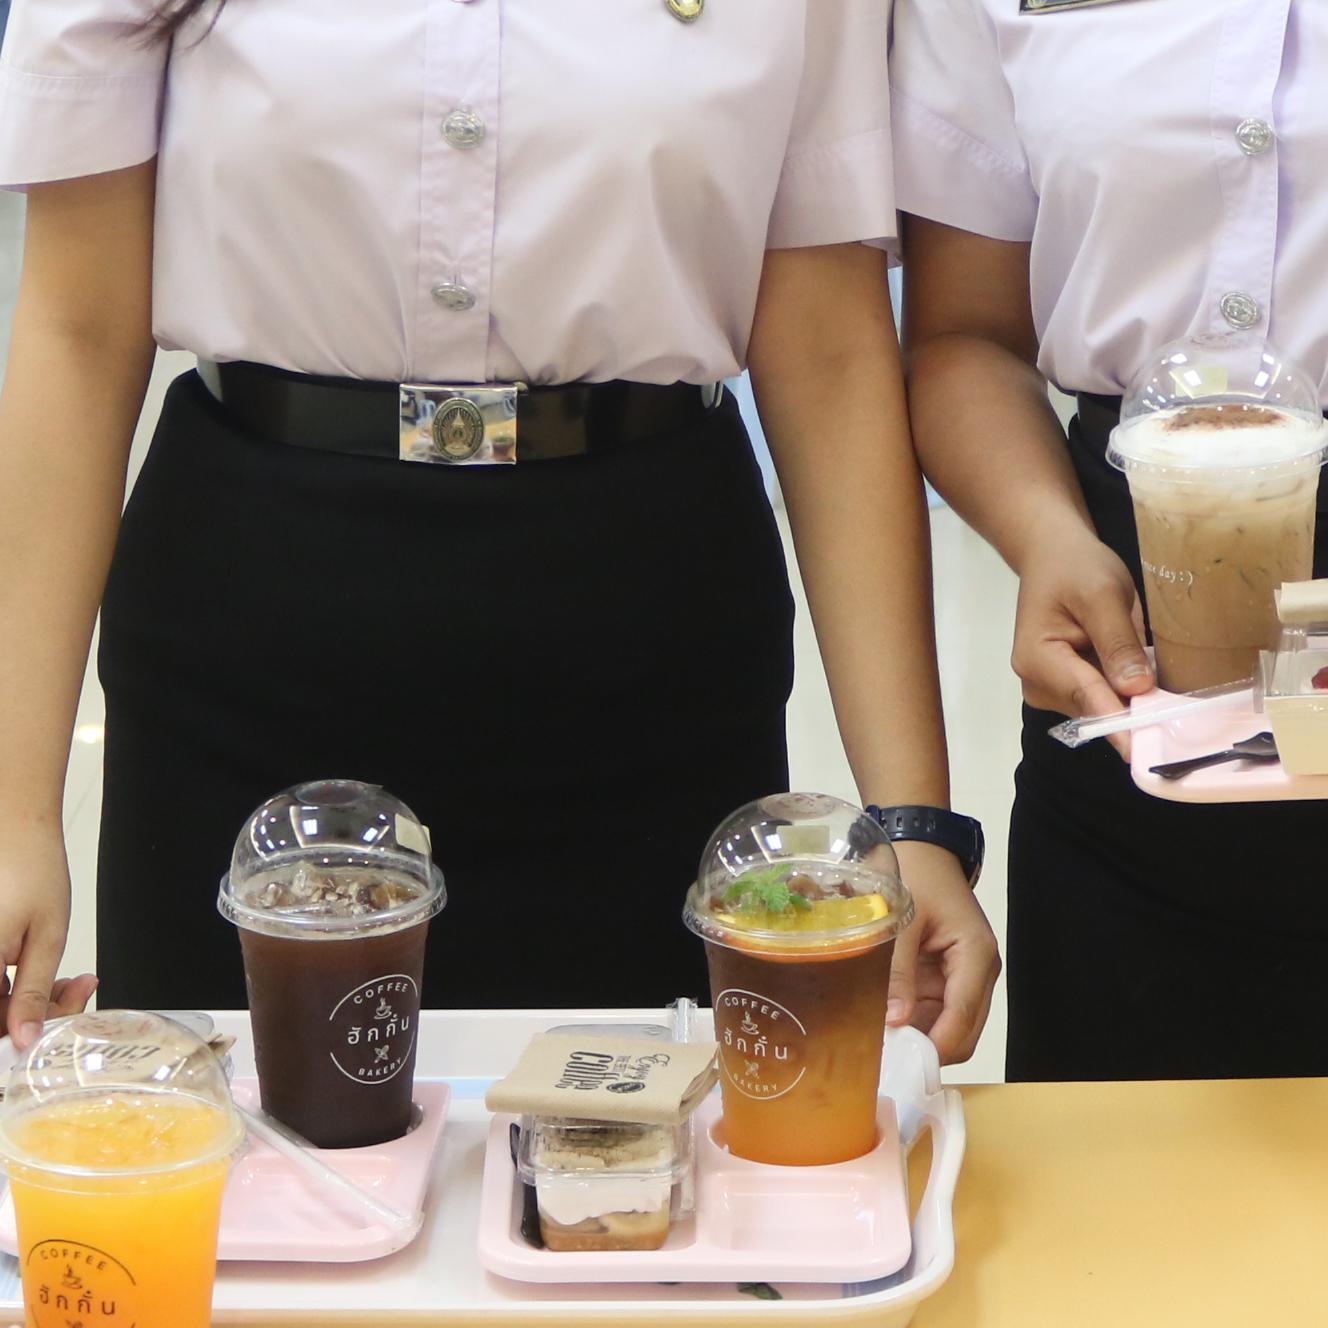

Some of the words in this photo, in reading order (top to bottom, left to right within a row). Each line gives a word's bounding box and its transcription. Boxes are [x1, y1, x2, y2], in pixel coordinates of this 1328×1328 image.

[353, 982, 409, 1004] COFFEE
[724, 996, 780, 1020] COFFEE
[358, 1057, 402, 1076] BAKERY
[733, 1073, 777, 1092] BAKERY
[39, 1248, 107, 1270] COFFEE
